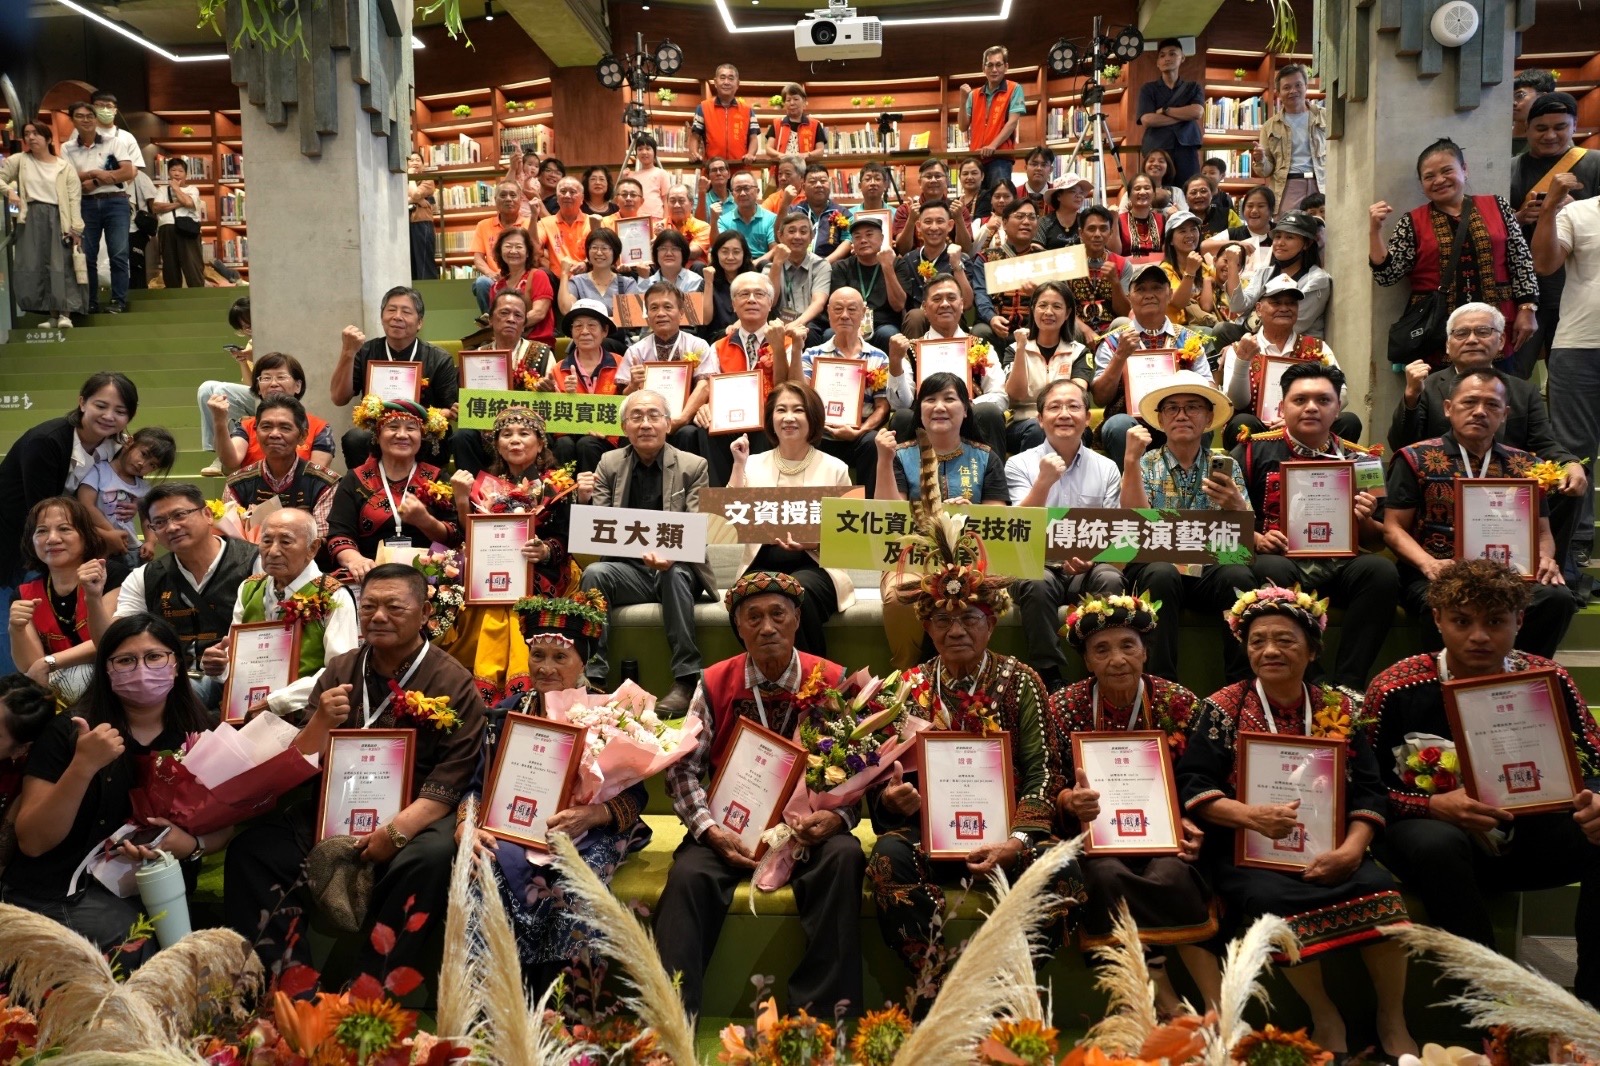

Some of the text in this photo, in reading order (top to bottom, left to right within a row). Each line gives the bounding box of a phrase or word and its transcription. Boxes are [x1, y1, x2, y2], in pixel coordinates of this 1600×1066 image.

[590, 518, 684, 549] 五大類
[836, 510, 1031, 542] 文化資存技術
[1046, 518, 1241, 552] 傳統表演藝術
